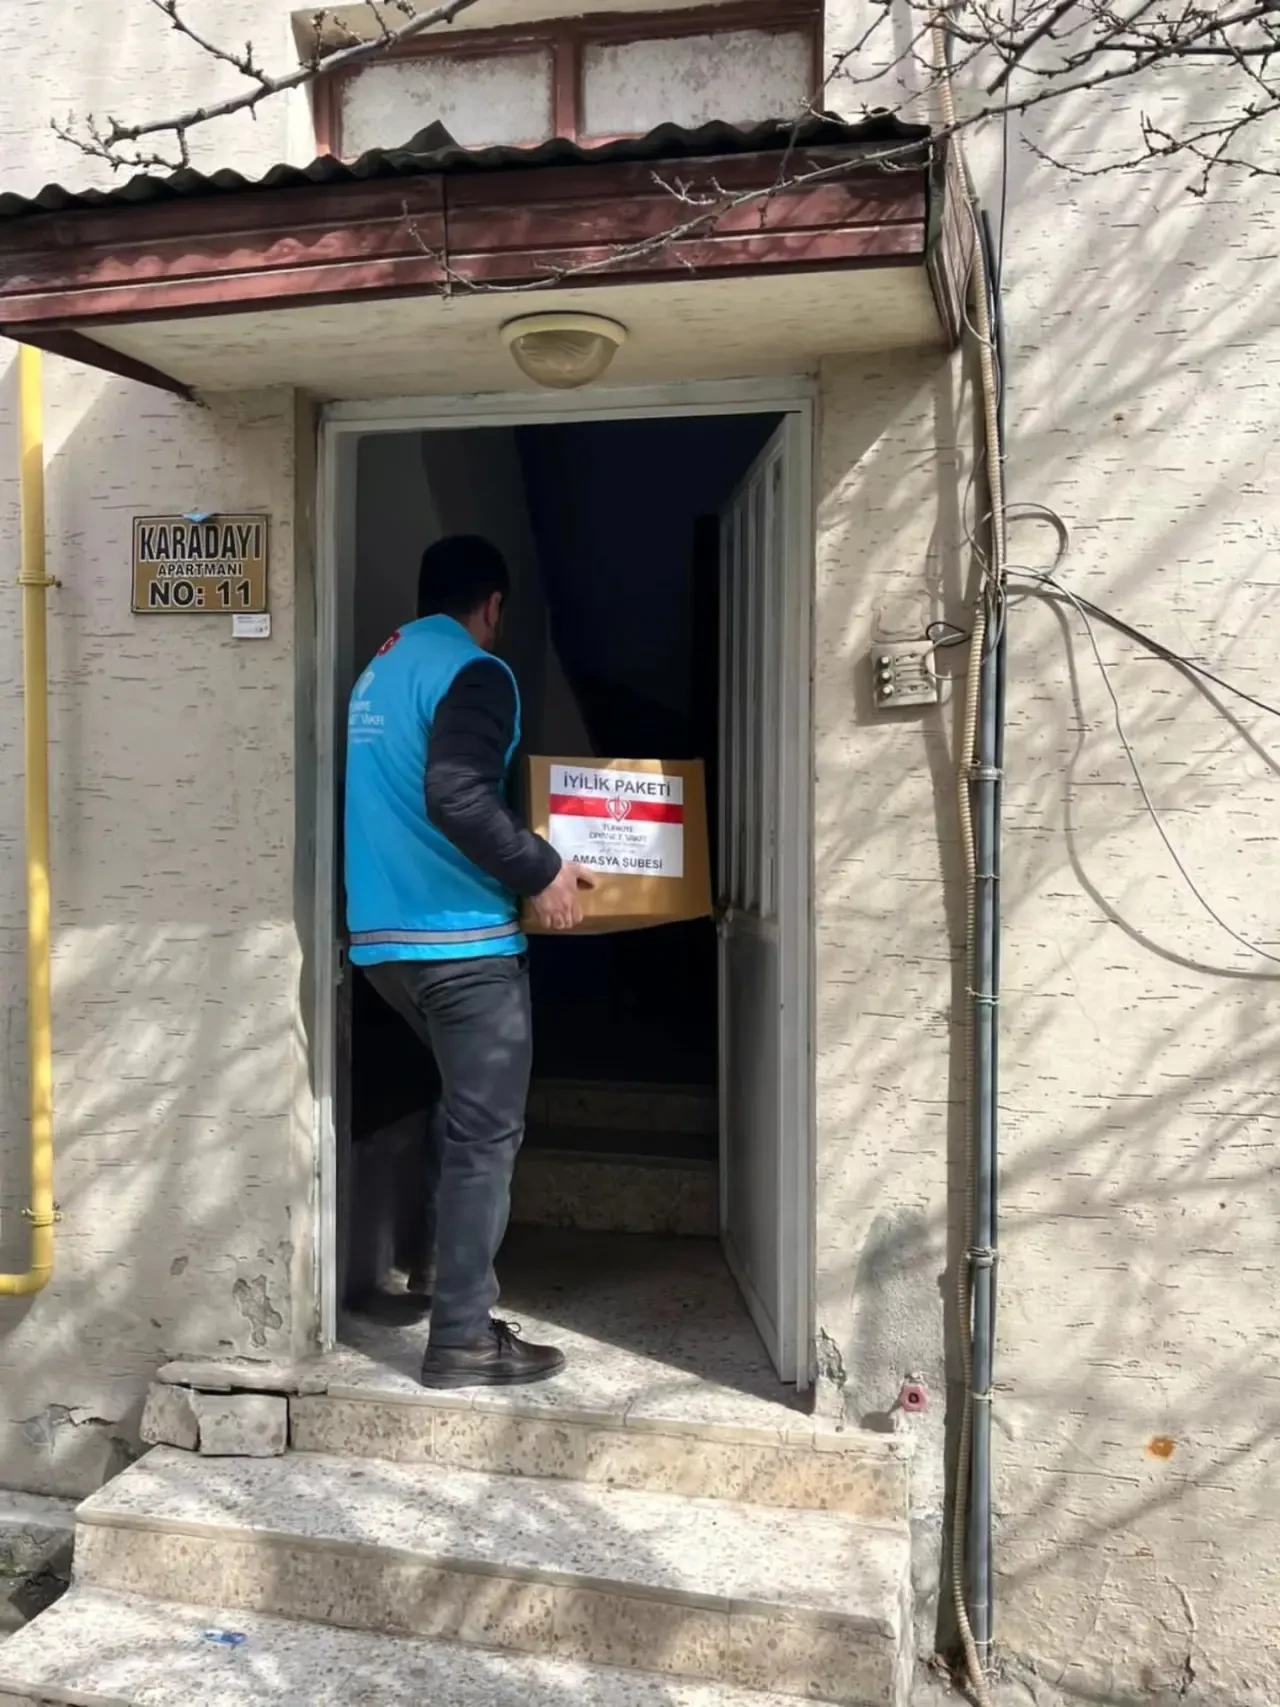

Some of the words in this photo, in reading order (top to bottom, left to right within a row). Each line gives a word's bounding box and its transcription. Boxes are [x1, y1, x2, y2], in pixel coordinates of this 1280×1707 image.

[140, 524, 261, 560] KARADAYI
[158, 563, 243, 577] APARTMANI
[150, 581, 204, 606] NO:
[217, 580, 250, 606] 11
[563, 771, 610, 791] İYİLİK
[615, 779, 671, 797] PAKETİ
[572, 854, 620, 867] AMASYA
